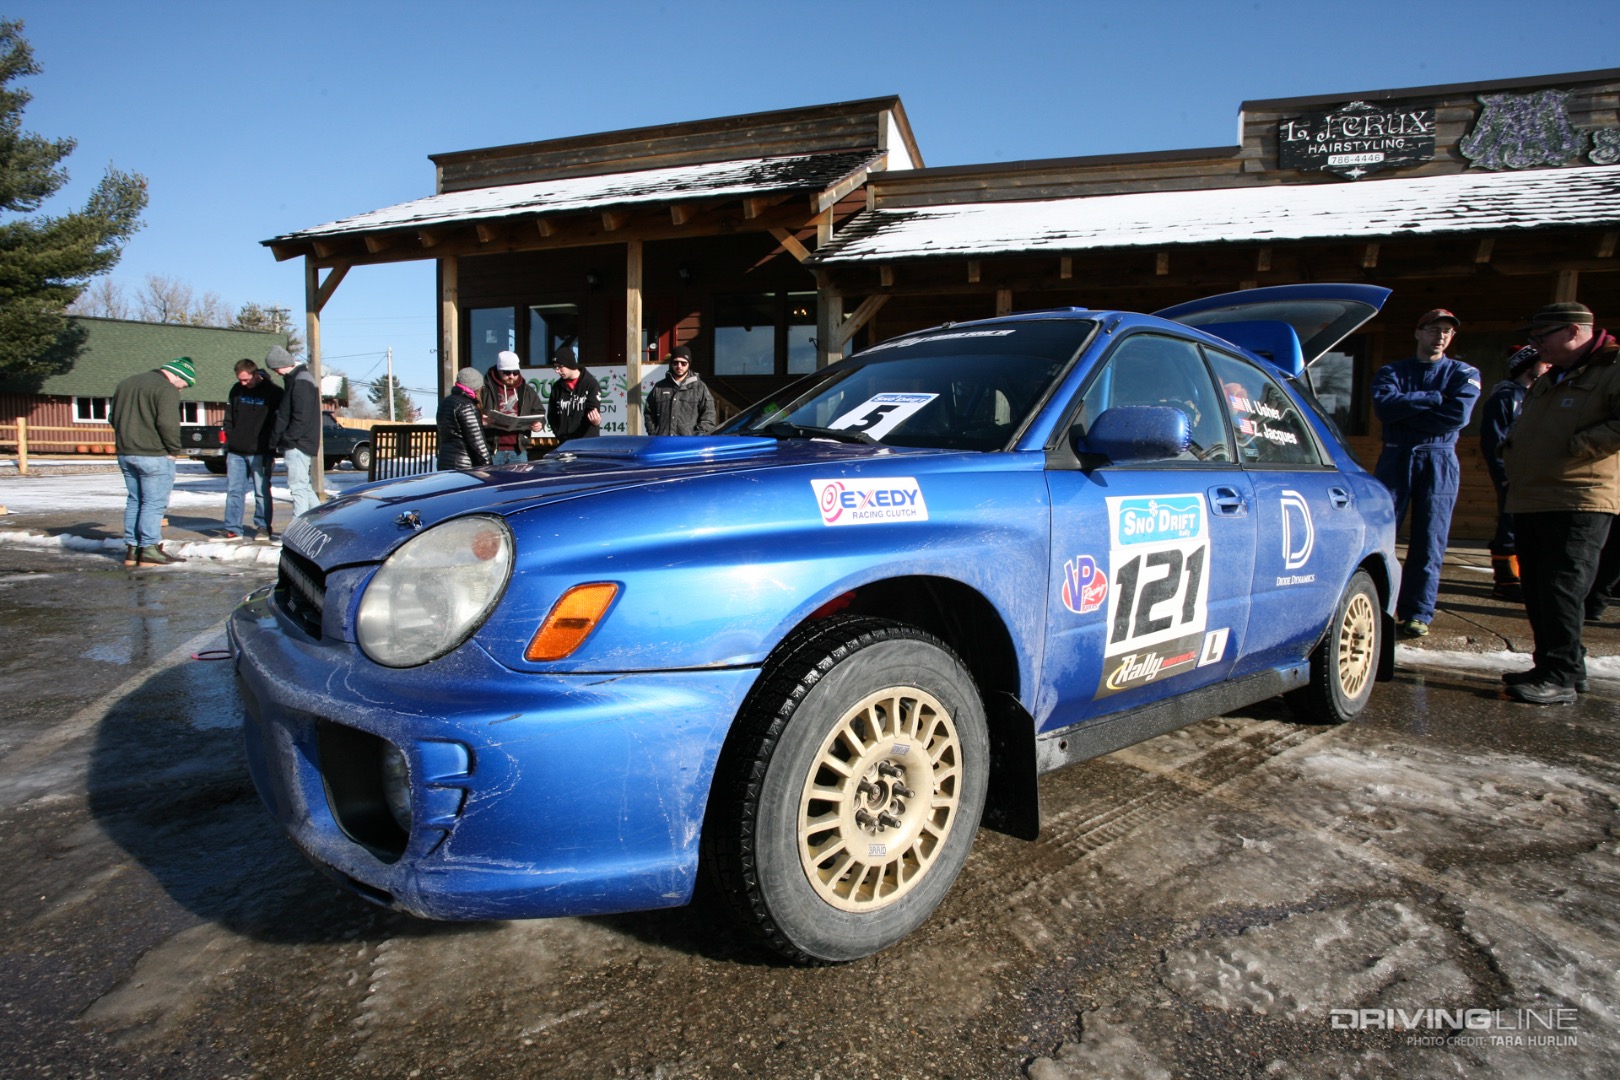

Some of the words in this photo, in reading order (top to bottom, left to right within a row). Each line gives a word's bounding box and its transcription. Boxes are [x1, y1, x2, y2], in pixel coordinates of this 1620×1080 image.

[1308, 139, 1405, 154] HAIRSTYLING
[1331, 154, 1381, 164] 786-4446
[843, 405, 900, 433] 5
[1263, 423, 1297, 446] Jacques
[840, 489, 918, 509] EXEDY
[852, 511, 883, 520] RACING
[886, 509, 916, 518] CLUTCH
[1110, 544, 1206, 645] 121
[1206, 634, 1218, 661] L
[1114, 652, 1164, 685] Rally
